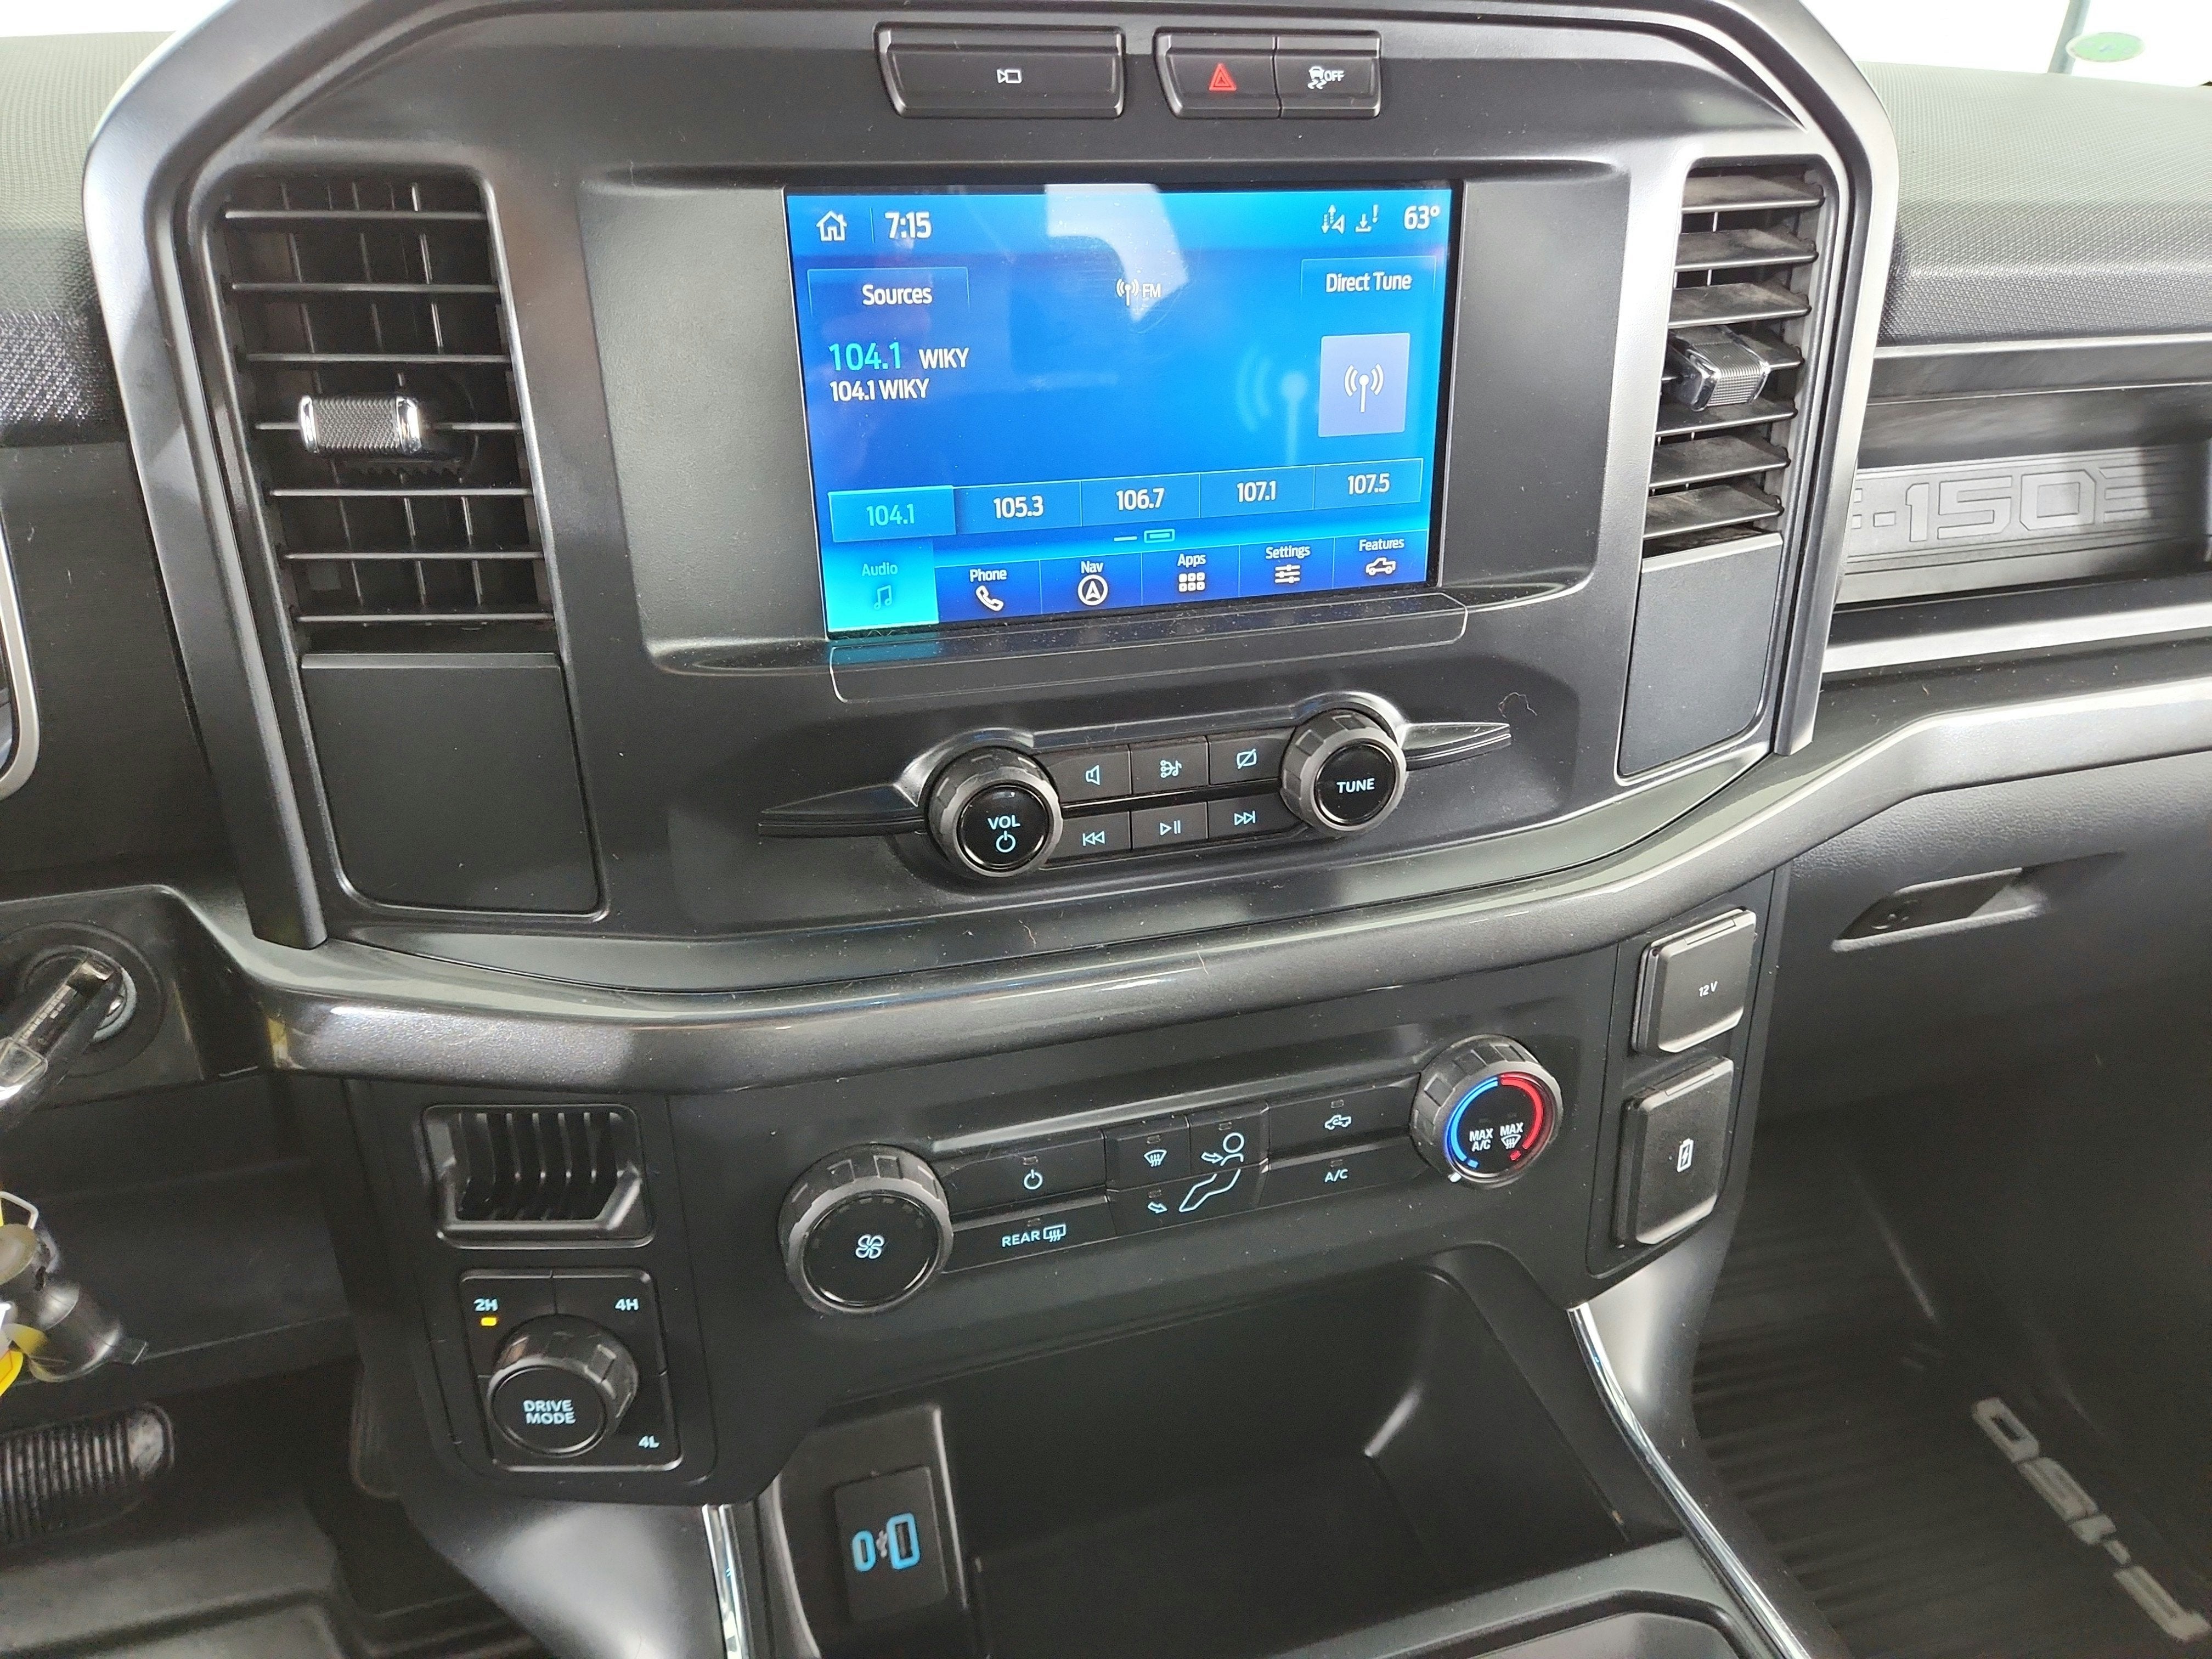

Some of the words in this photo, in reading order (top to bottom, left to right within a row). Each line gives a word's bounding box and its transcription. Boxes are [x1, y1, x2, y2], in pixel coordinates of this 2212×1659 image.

[1324, 69, 1345, 83] OFF
[884, 211, 932, 240] 7:15
[1325, 273, 1371, 292] Direct
[1373, 271, 1413, 291] Tune
[862, 284, 933, 306] Sources
[1142, 283, 1161, 298] FM
[828, 342, 901, 371] 104.1
[918, 347, 969, 369] WIKY
[830, 380, 876, 402] 104.1
[878, 378, 929, 400] WIKY
[1347, 473, 1390, 495] 107.5
[1116, 488, 1165, 511] 106.7
[1237, 481, 1276, 503] 107.1
[993, 495, 1043, 518] 105.3
[1850, 470, 2096, 543] -150
[866, 503, 915, 527] 104.1
[1265, 545, 1311, 559] Settings
[1359, 538, 1404, 551] Features
[1080, 561, 1104, 575] Nav
[1177, 553, 1206, 568] Apps
[862, 562, 898, 577] Audio
[969, 568, 1007, 583] Phone
[1336, 777, 1375, 794] TUNE
[987, 814, 1021, 830] VOL
[1710, 980, 1718, 992] V
[1469, 1128, 1493, 1142] MAX
[1500, 1122, 1523, 1136] MAX
[1471, 1139, 1491, 1152] A/C
[1324, 1169, 1348, 1183] A/C
[1002, 1229, 1041, 1248] REAR
[473, 1298, 498, 1312] 2H
[615, 1298, 639, 1311] 4H
[523, 1400, 573, 1413] DRIVE
[526, 1412, 576, 1424] MODE
[638, 1435, 660, 1448] 4L
[1974, 1396, 2211, 1643] F-150
